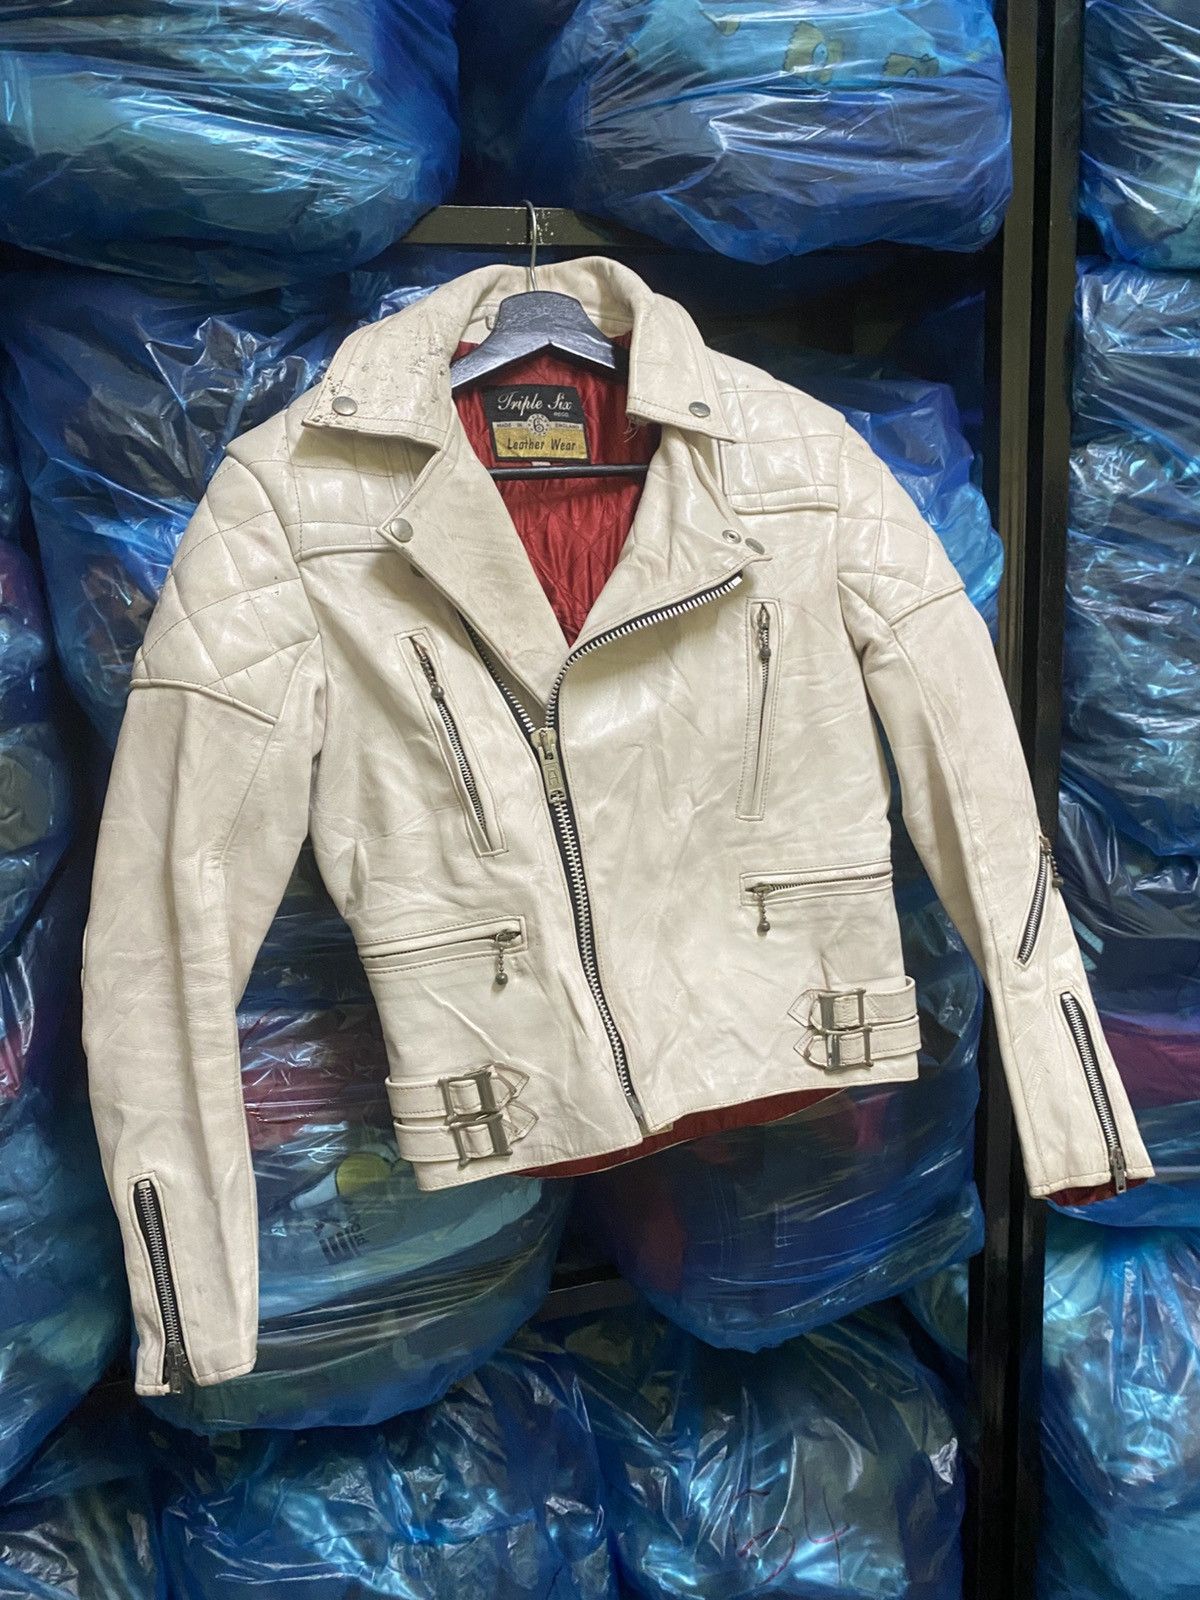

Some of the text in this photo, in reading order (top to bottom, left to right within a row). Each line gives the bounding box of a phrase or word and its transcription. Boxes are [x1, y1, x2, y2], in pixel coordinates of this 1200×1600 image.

[497, 391, 572, 416] Triple Six
[507, 438, 576, 451] Leather Wear
